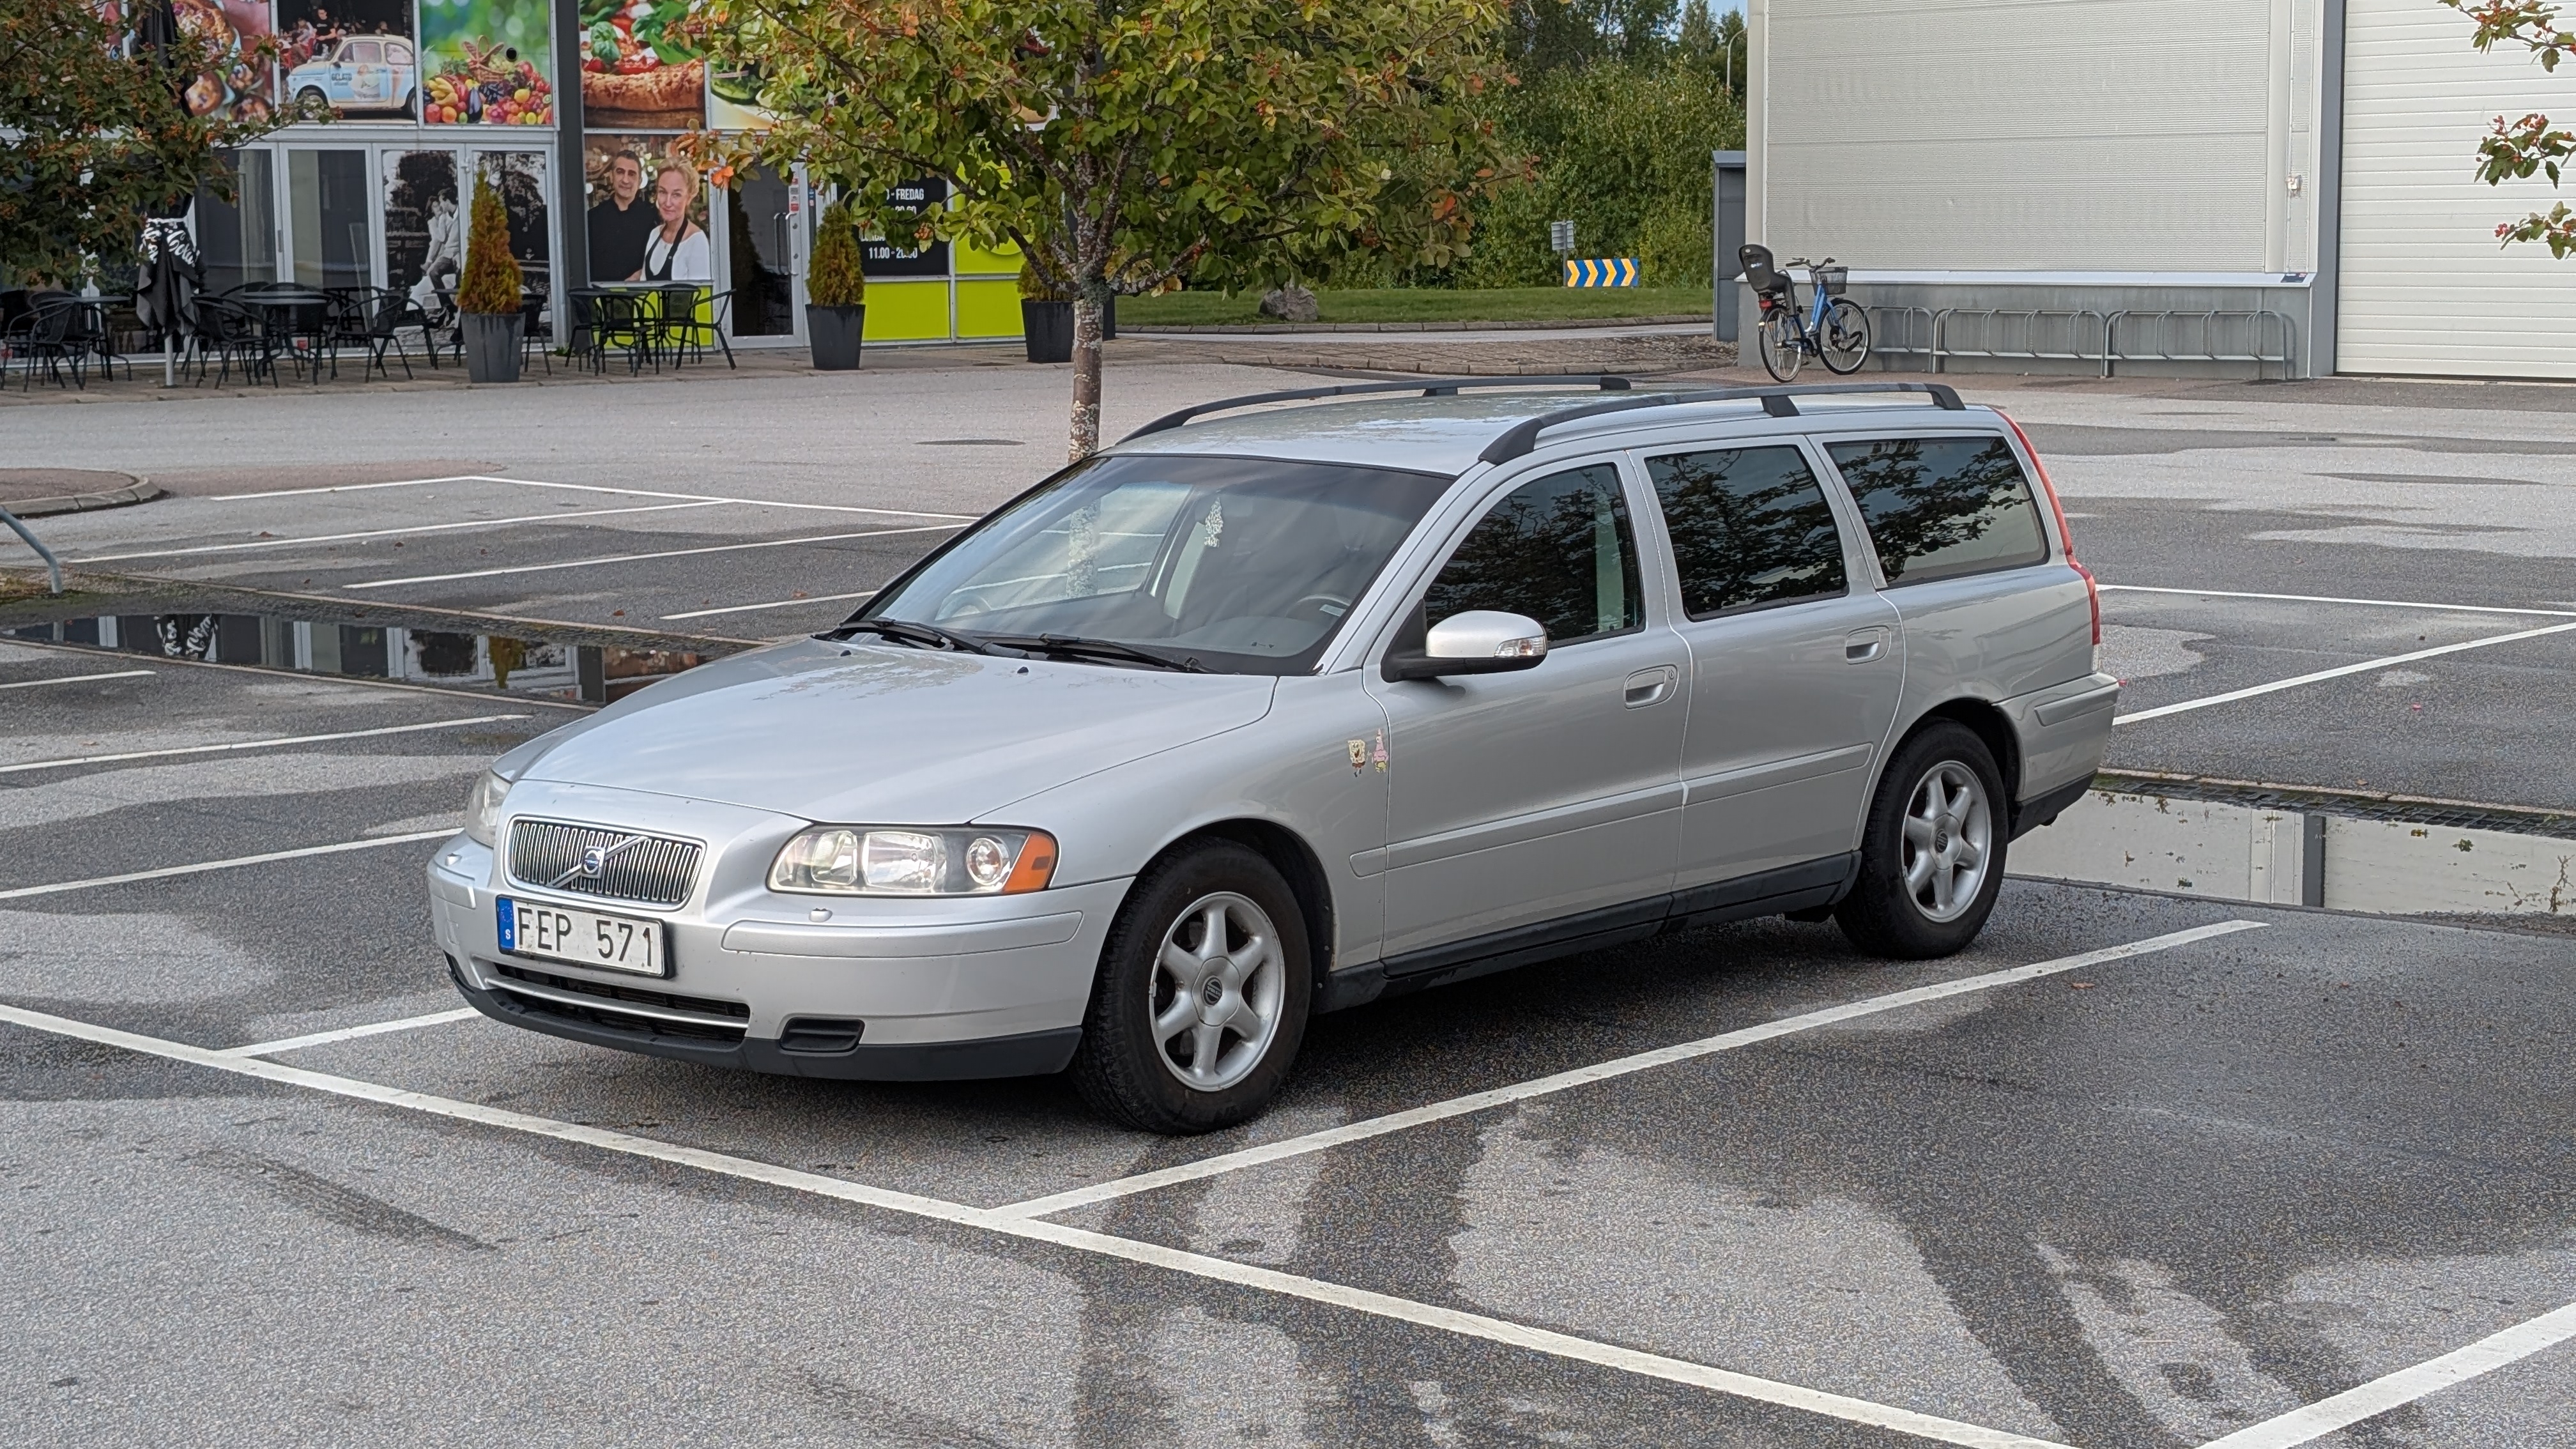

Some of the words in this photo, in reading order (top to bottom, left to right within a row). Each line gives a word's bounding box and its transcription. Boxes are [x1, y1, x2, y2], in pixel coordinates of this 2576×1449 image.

[896, 188, 924, 201] FREDAG
[869, 247, 890, 259] 11.00
[505, 928, 511, 940] S
[517, 907, 572, 952] FEP
[596, 919, 652, 967] 571
